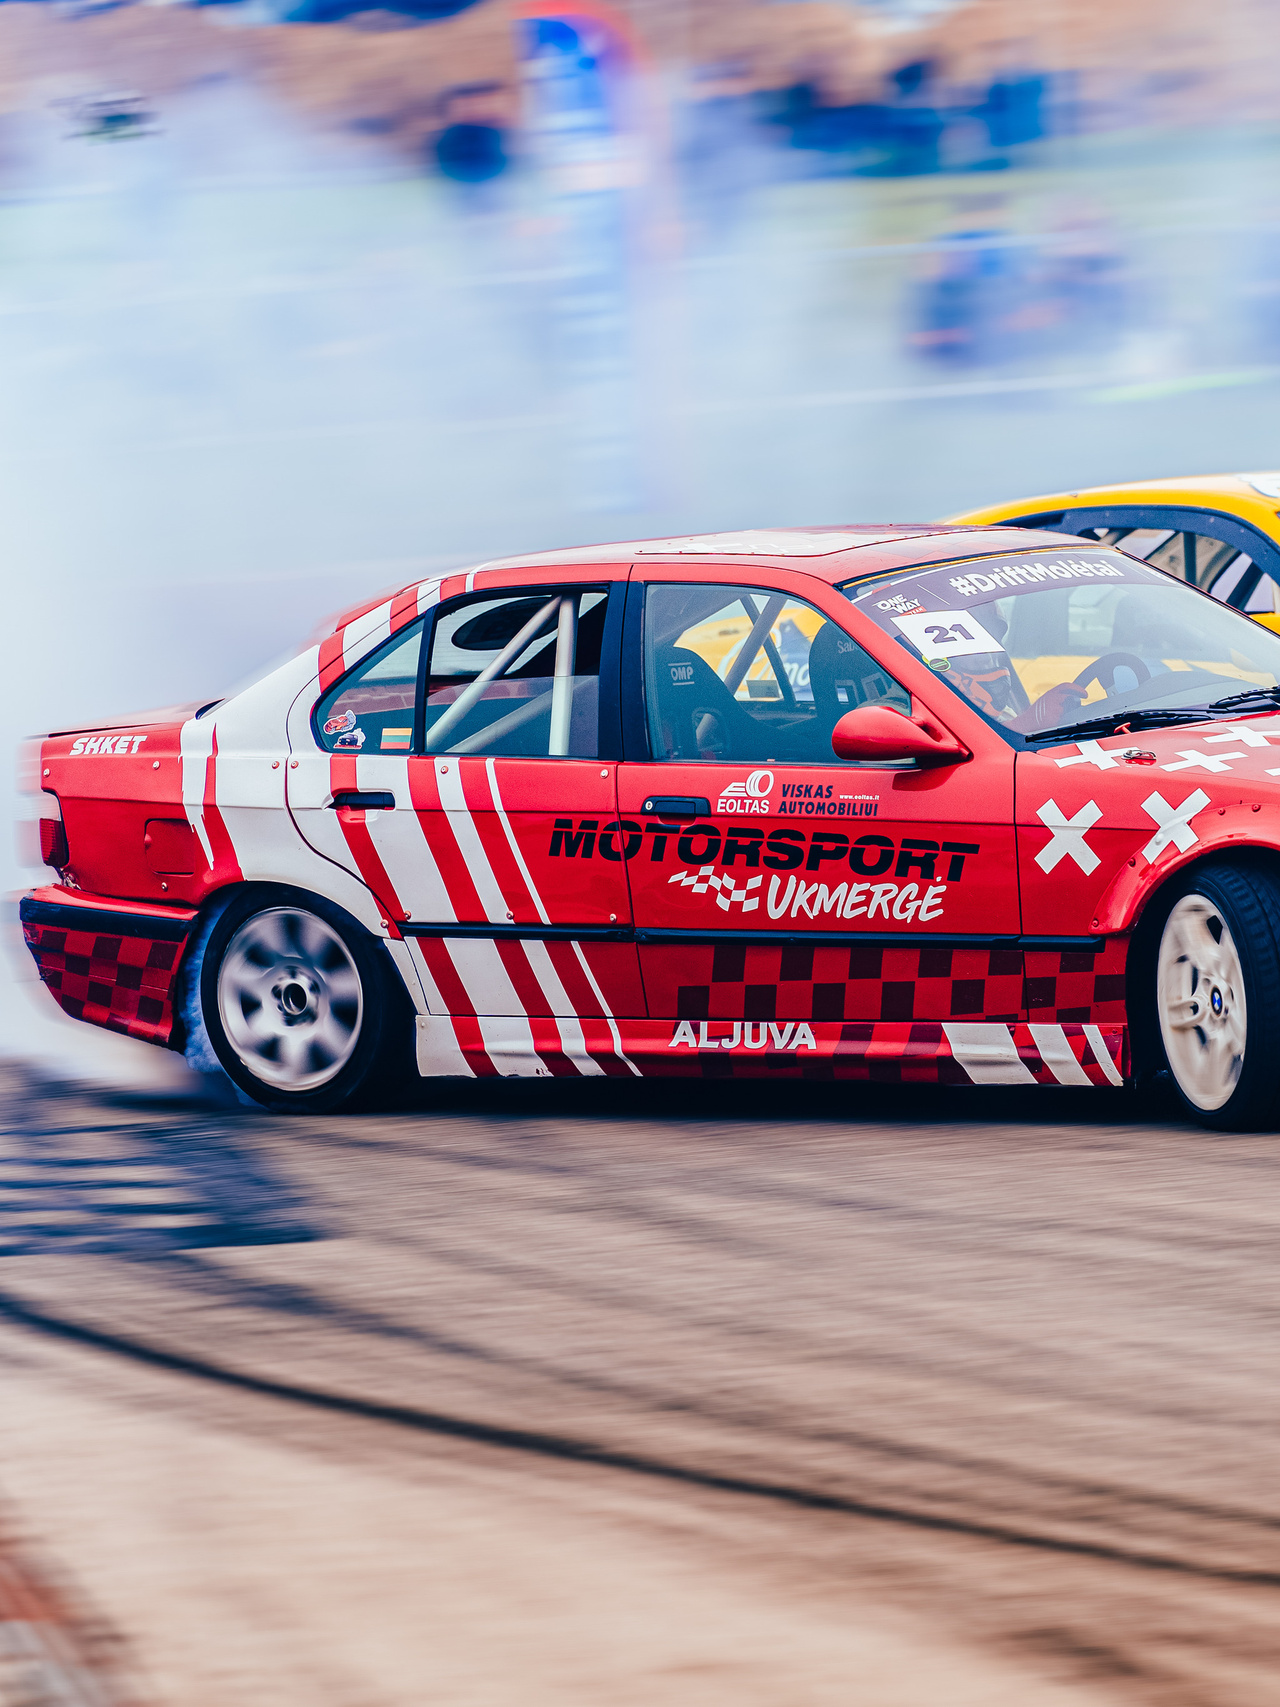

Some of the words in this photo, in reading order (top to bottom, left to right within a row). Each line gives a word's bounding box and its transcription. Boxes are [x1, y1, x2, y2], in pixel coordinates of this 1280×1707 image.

[875, 594, 908, 611] ONE
[893, 599, 921, 614] WAY
[924, 624, 975, 644] 21
[671, 666, 694, 681] OMP
[69, 735, 148, 756] SHKET
[782, 784, 833, 798] VISKAS
[717, 799, 770, 814] EOLTAS
[778, 801, 878, 816] AUTOMOBILIUI
[548, 818, 980, 882] MOTORSPORT
[668, 1020, 817, 1050] ALJUVA
